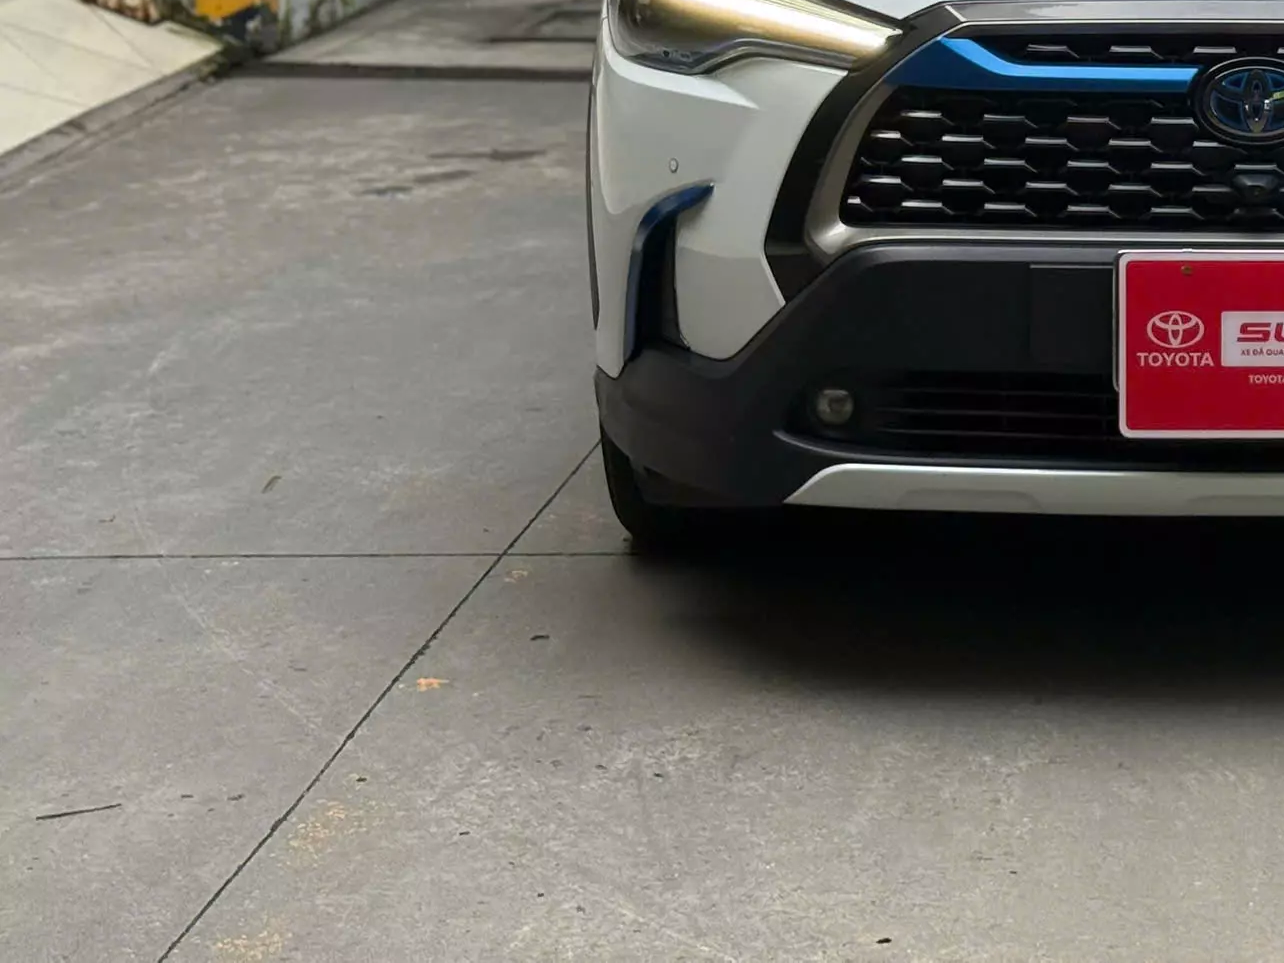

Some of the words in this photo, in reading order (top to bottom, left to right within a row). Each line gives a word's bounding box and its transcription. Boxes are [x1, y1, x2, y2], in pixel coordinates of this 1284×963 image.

[1240, 348, 1251, 356] XE
[1265, 348, 1284, 357] QUA
[1136, 351, 1215, 368] TOYOTA
